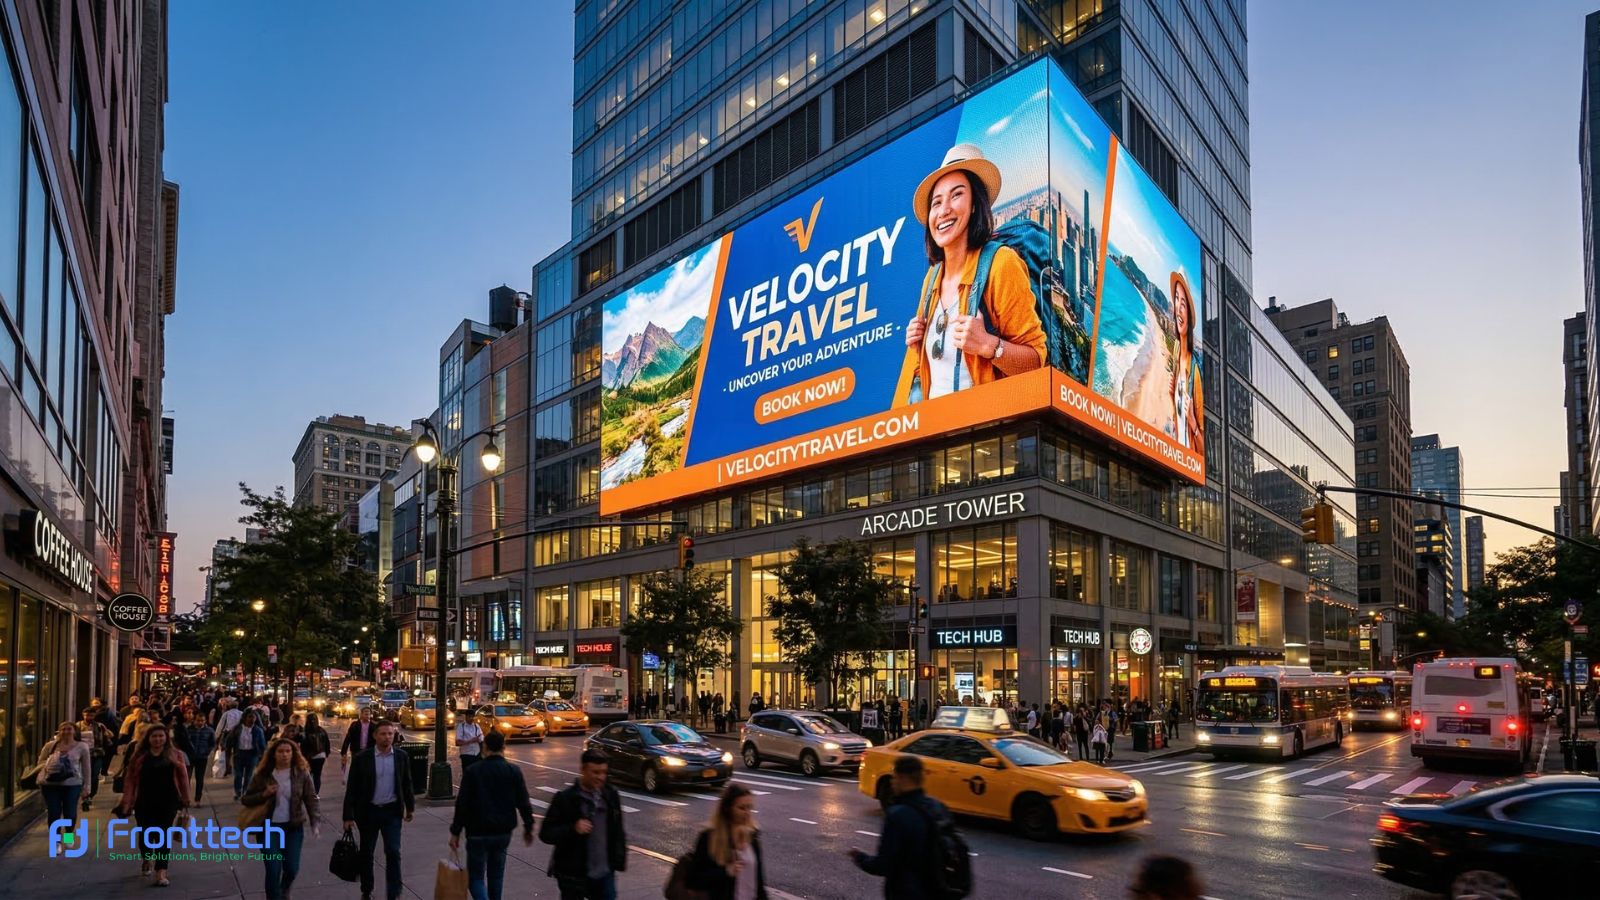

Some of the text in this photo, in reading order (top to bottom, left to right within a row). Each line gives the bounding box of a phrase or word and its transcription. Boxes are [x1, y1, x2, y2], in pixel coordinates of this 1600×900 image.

[728, 216, 906, 330] VELOCITY
[741, 282, 877, 367] TRAVEL
[729, 325, 893, 393] UNCOVER YOUR ADVENTURE
[762, 378, 846, 417] BOOK NOW!
[725, 411, 919, 478] VELOCITYTRAVEL.COM
[1060, 384, 1202, 476] BOOK NOW! VELOCITYTRAVEL.COM
[861, 492, 1026, 536] ARCADE TOWER
[34, 510, 93, 594] COFFEE HOUSE
[112, 605, 148, 614] COFFEE
[115, 613, 147, 621] HOUSE
[936, 629, 1003, 645] TECH HUB
[1063, 629, 1100, 645] TECH HUB
